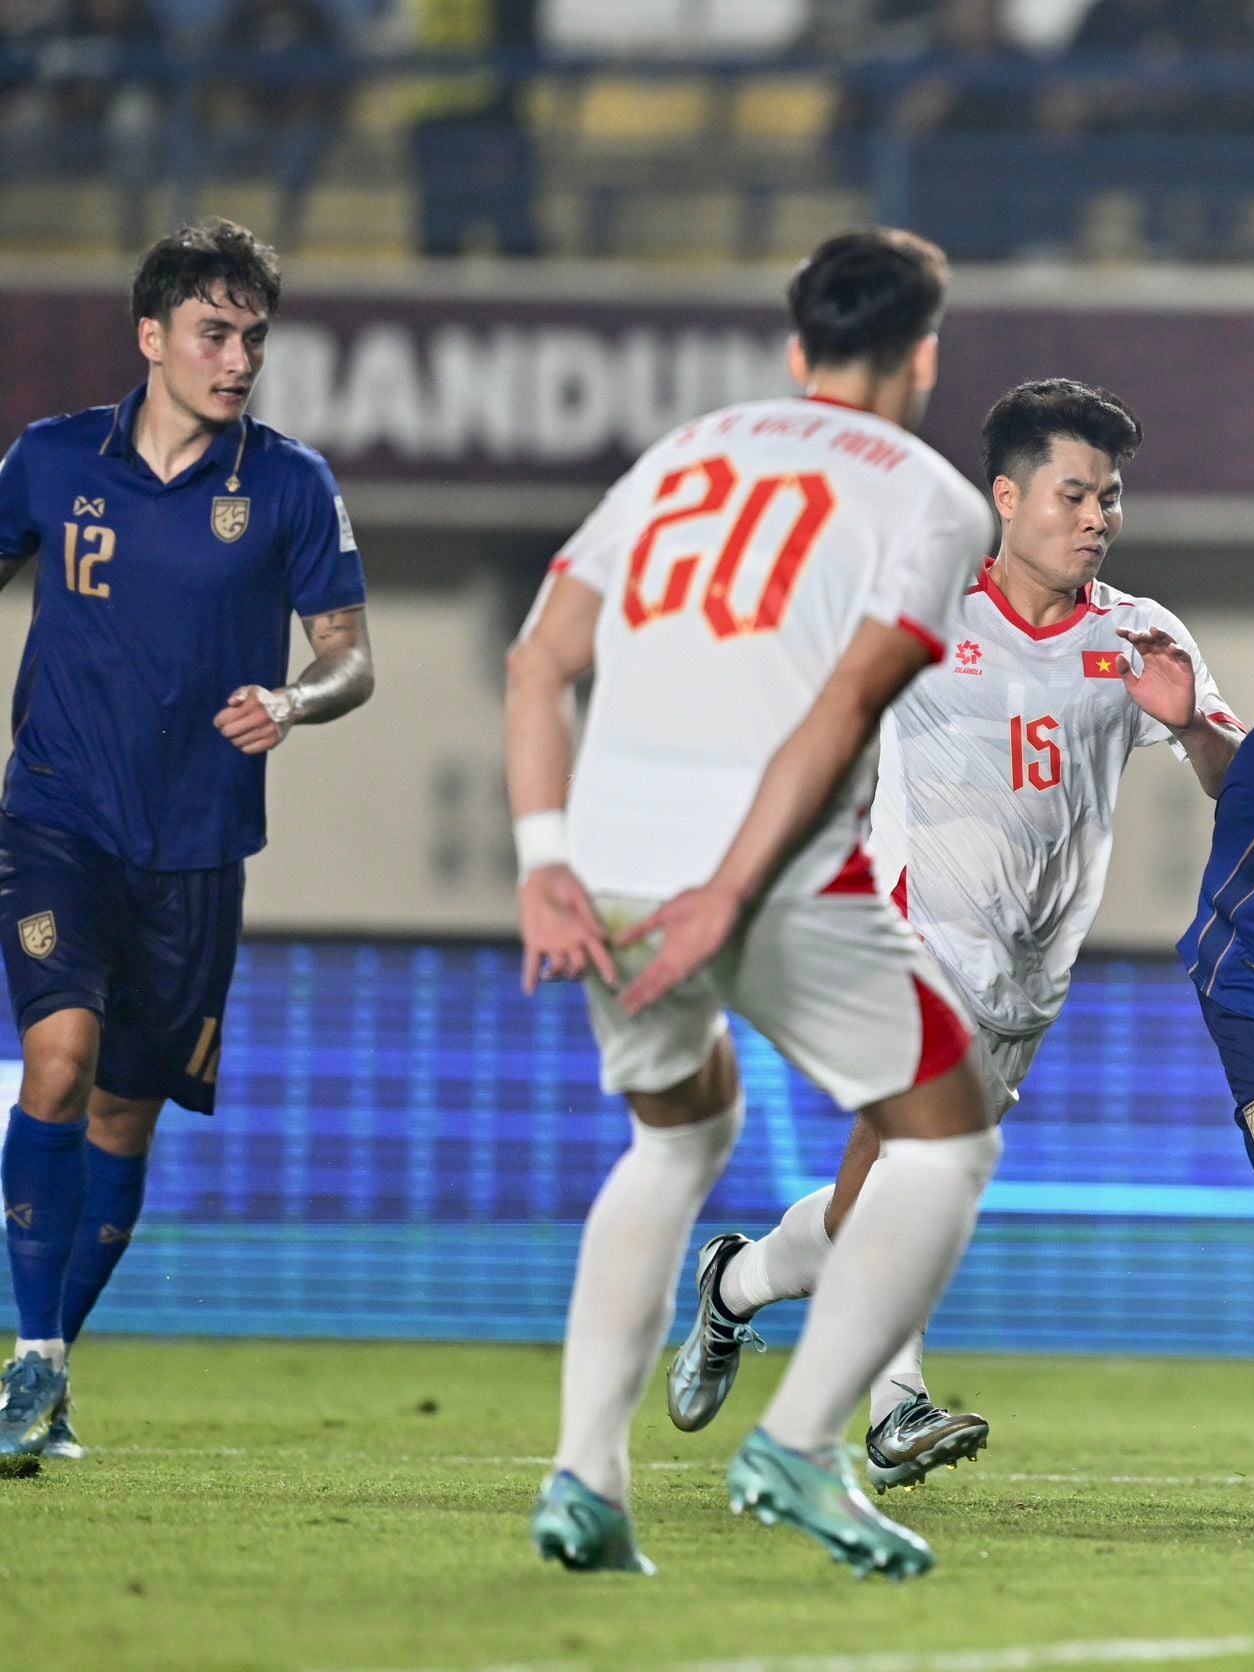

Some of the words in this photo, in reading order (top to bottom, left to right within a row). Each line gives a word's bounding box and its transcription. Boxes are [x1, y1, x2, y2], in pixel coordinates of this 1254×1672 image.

[64, 522, 116, 599] 12
[623, 453, 838, 642] 20
[1010, 715, 1062, 792] 15
